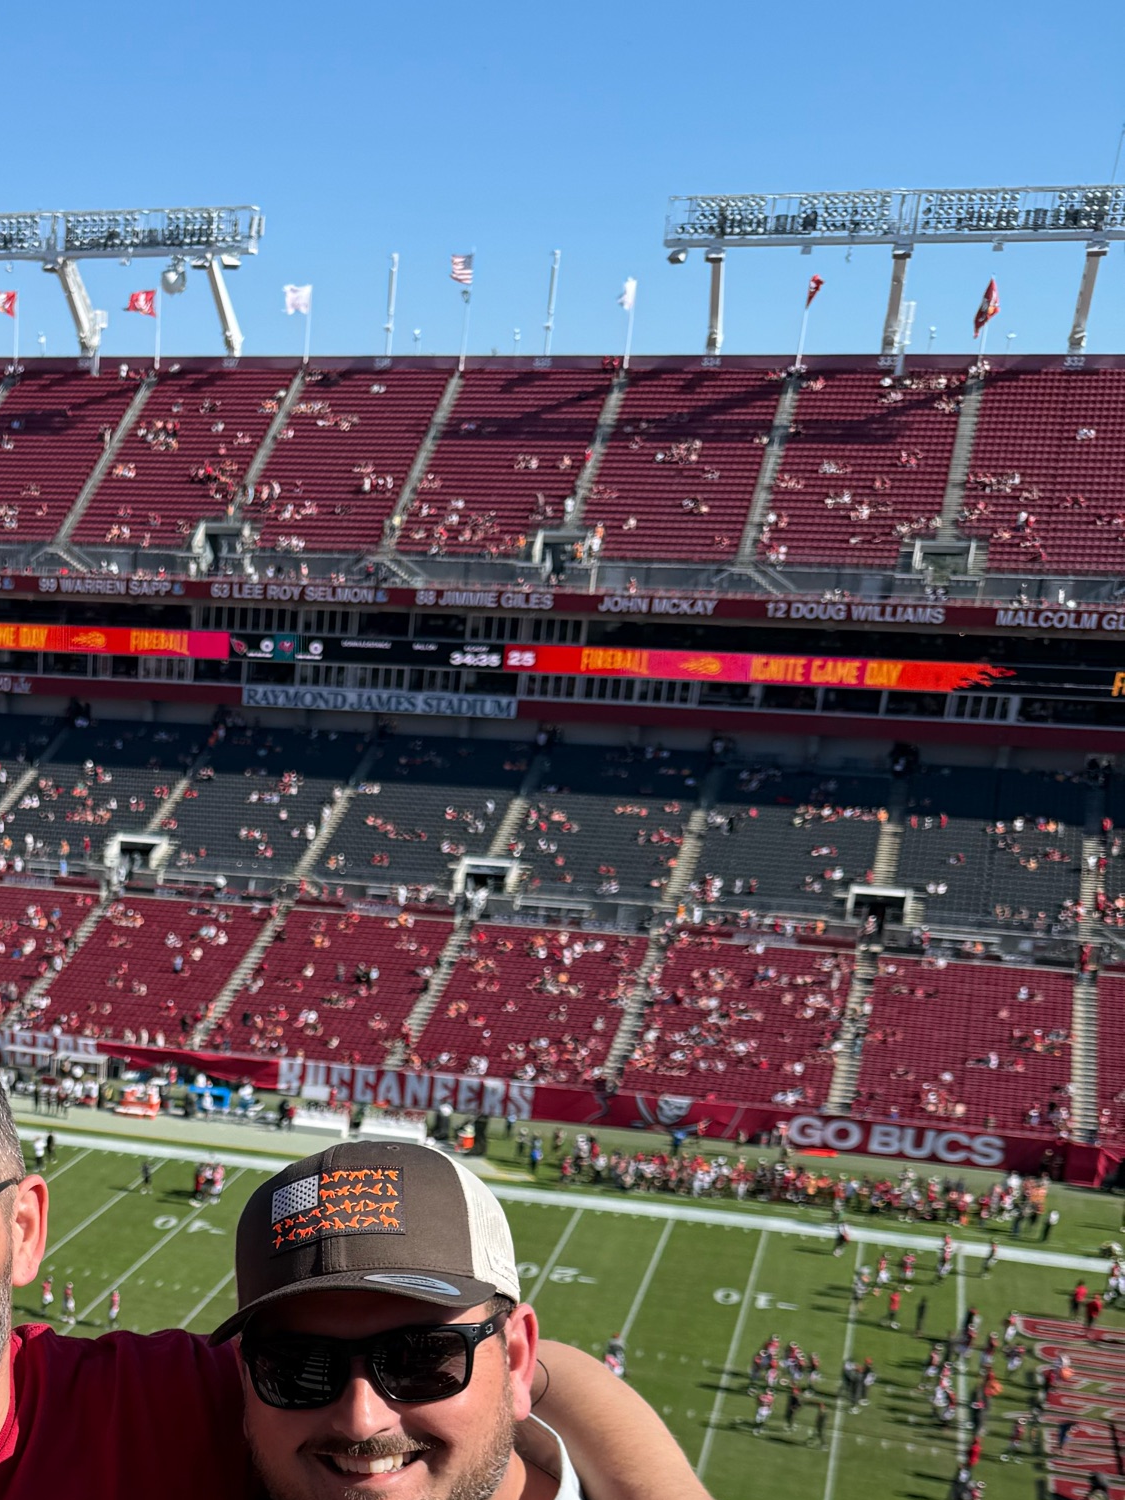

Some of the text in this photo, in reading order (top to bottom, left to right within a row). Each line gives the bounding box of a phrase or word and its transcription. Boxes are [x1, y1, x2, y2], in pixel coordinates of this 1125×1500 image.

[39, 577, 172, 596] 99 WARREN SAPP
[211, 582, 375, 603] 63 LEE ROY SELMON
[438, 591, 498, 608] JIMMIE
[500, 592, 555, 610] GILES
[598, 597, 648, 614] JOHN
[766, 602, 946, 625] 12 DOUG WILLIAMS
[995, 610, 1099, 630] MALCOLM
[19, 626, 49, 649] DAY
[129, 631, 190, 655] FIREBALL
[580, 647, 903, 687] FIREBALL IGNITE GAME DAY
[247, 688, 517, 718] RAYMOND JAMES STADIUM
[277, 1056, 534, 1121] BUCCANEERS
[787, 1114, 1006, 1167] GO BUCS
